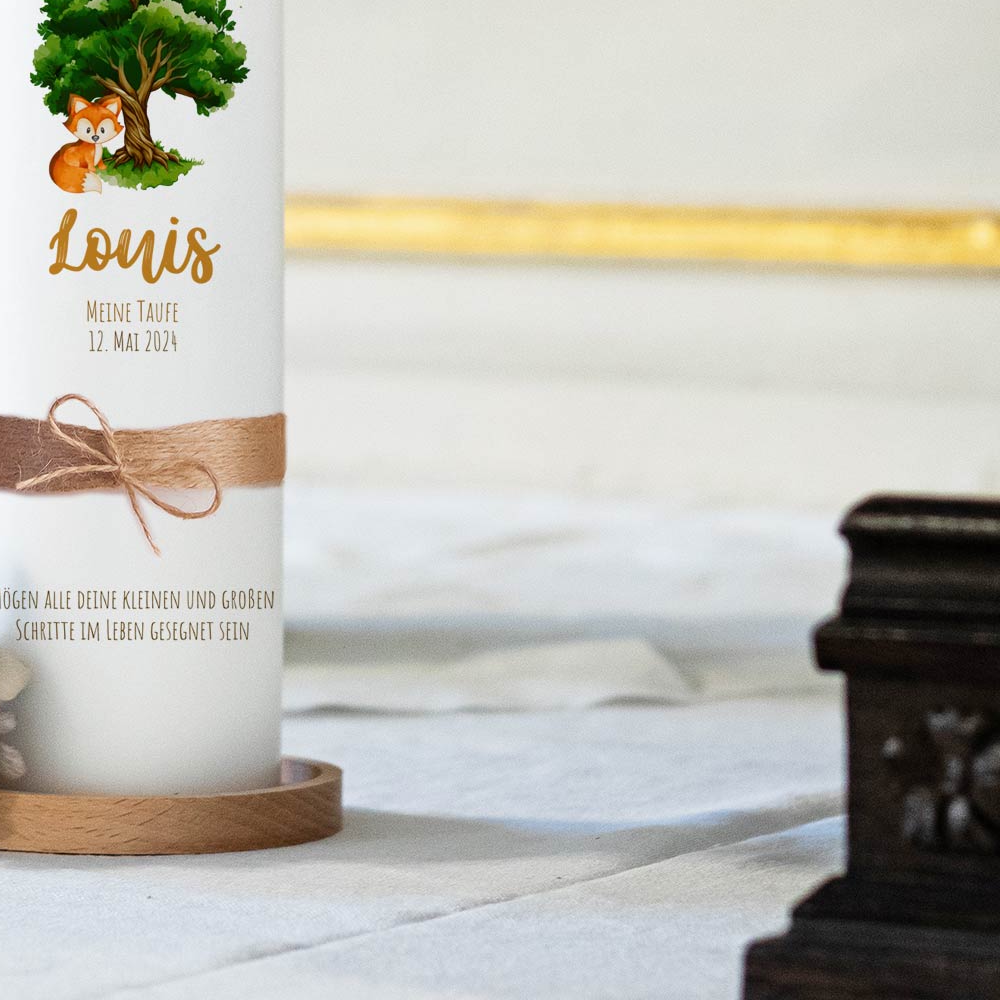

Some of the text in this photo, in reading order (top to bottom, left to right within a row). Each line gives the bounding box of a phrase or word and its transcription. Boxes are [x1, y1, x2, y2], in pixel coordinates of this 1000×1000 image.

[49, 208, 221, 284] Louis
[89, 330, 108, 352] 12.
[145, 330, 178, 352] 2024
